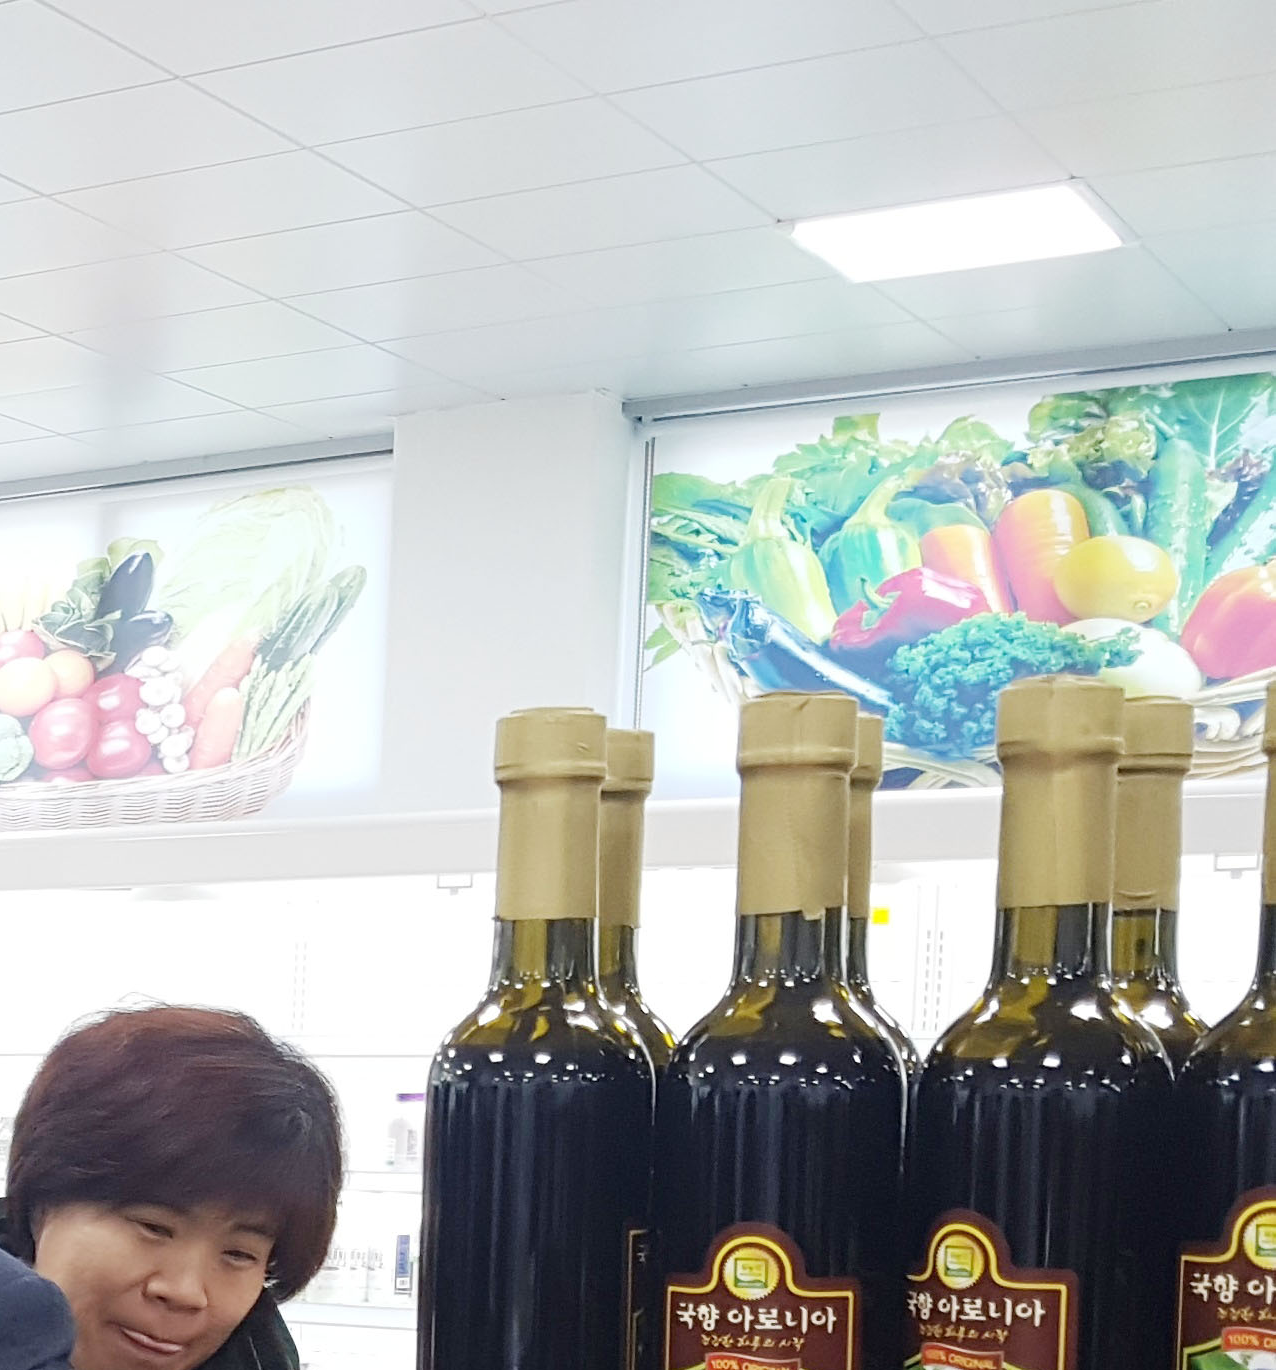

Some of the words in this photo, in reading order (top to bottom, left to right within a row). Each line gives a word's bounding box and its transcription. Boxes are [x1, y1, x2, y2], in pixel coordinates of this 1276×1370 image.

[1189, 1272, 1239, 1304] 국향
[676, 1302, 720, 1331] 국향
[726, 1304, 837, 1334] 아로니아
[906, 1291, 934, 1321] 국향
[937, 1294, 1047, 1327] 아로니아
[1228, 1333, 1260, 1347] 100%
[710, 1359, 740, 1370] 100%
[948, 1353, 997, 1370] ORIGINAL
